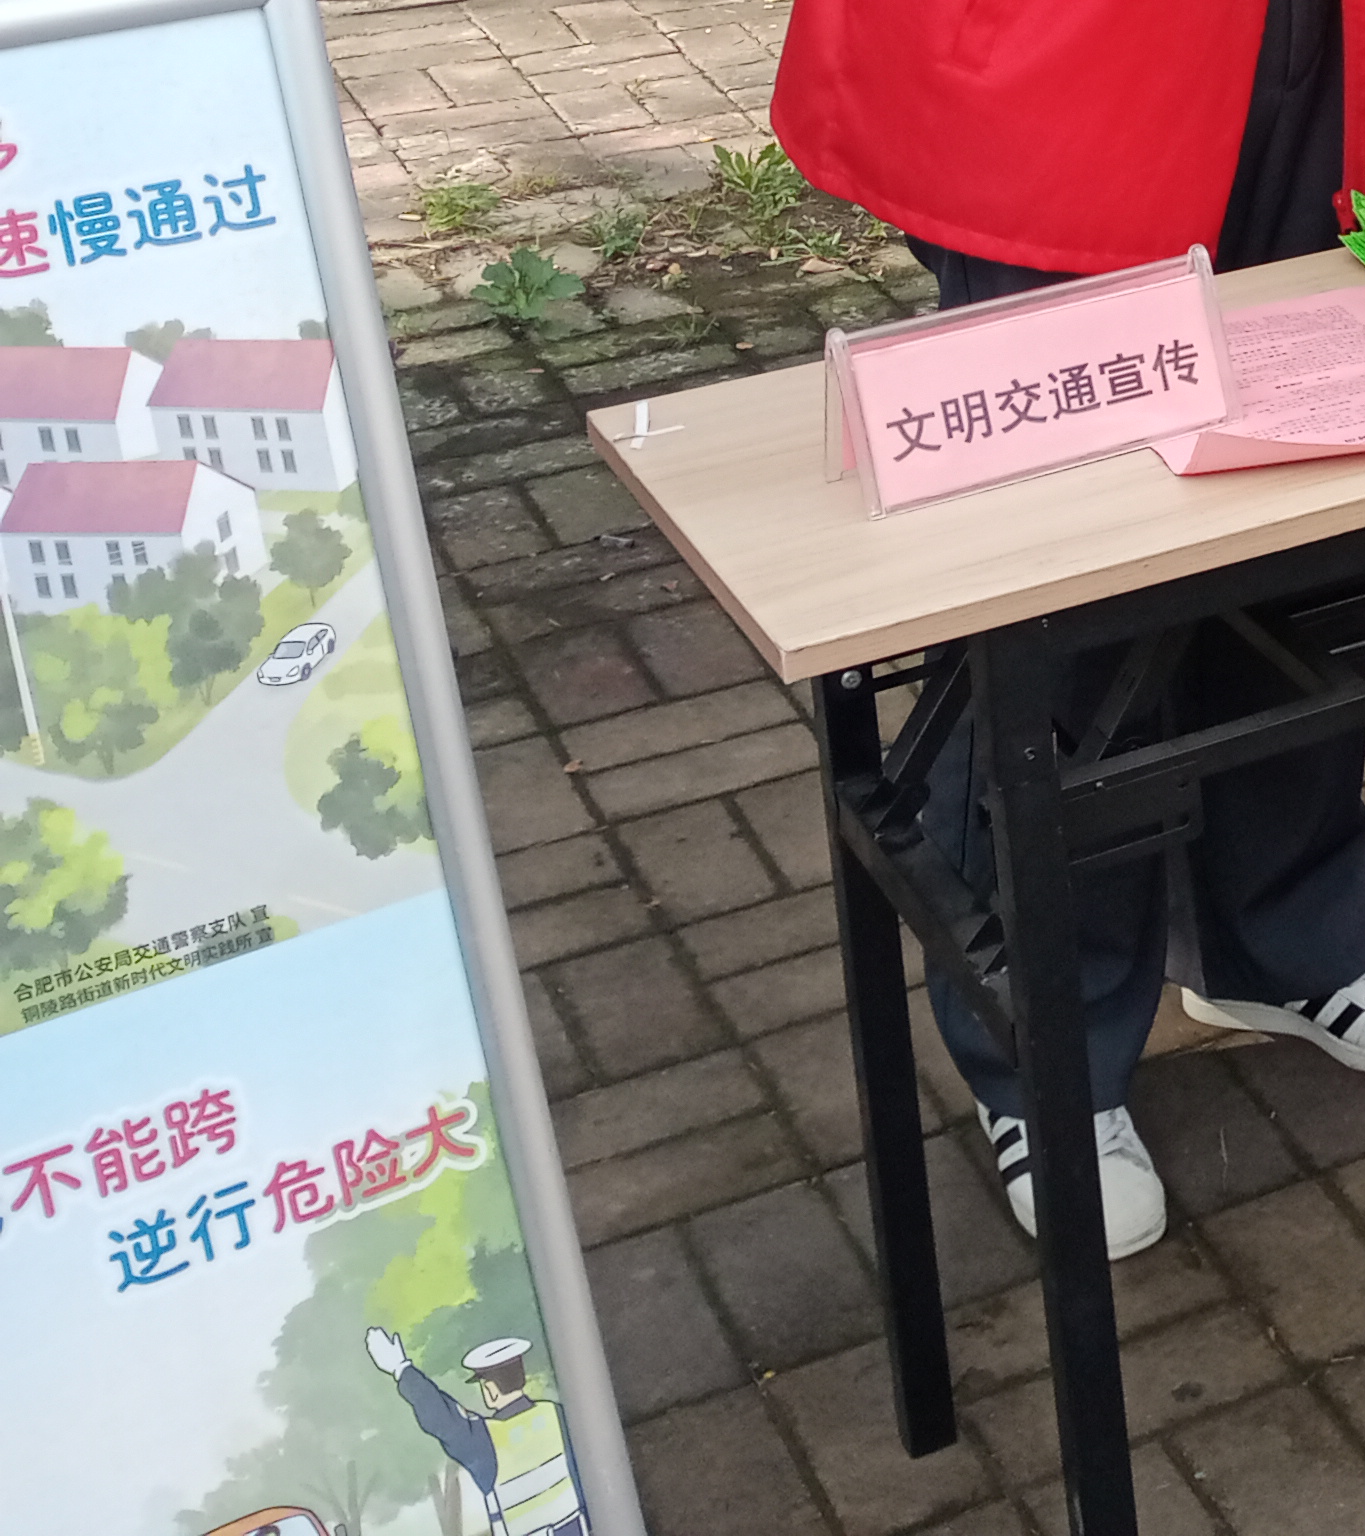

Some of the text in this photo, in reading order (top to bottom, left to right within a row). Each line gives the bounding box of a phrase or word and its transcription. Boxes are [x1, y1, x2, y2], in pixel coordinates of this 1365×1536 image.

[885, 338, 1201, 463] 文明交通宣传
[13, 904, 272, 1004] 合肥市公安局交通警察支队 宣
[20, 934, 253, 1024] 铜陵路街道新时代文明实践所
[3, 1087, 239, 1219] 不能跨
[108, 1104, 478, 1294] 逆行危险大
